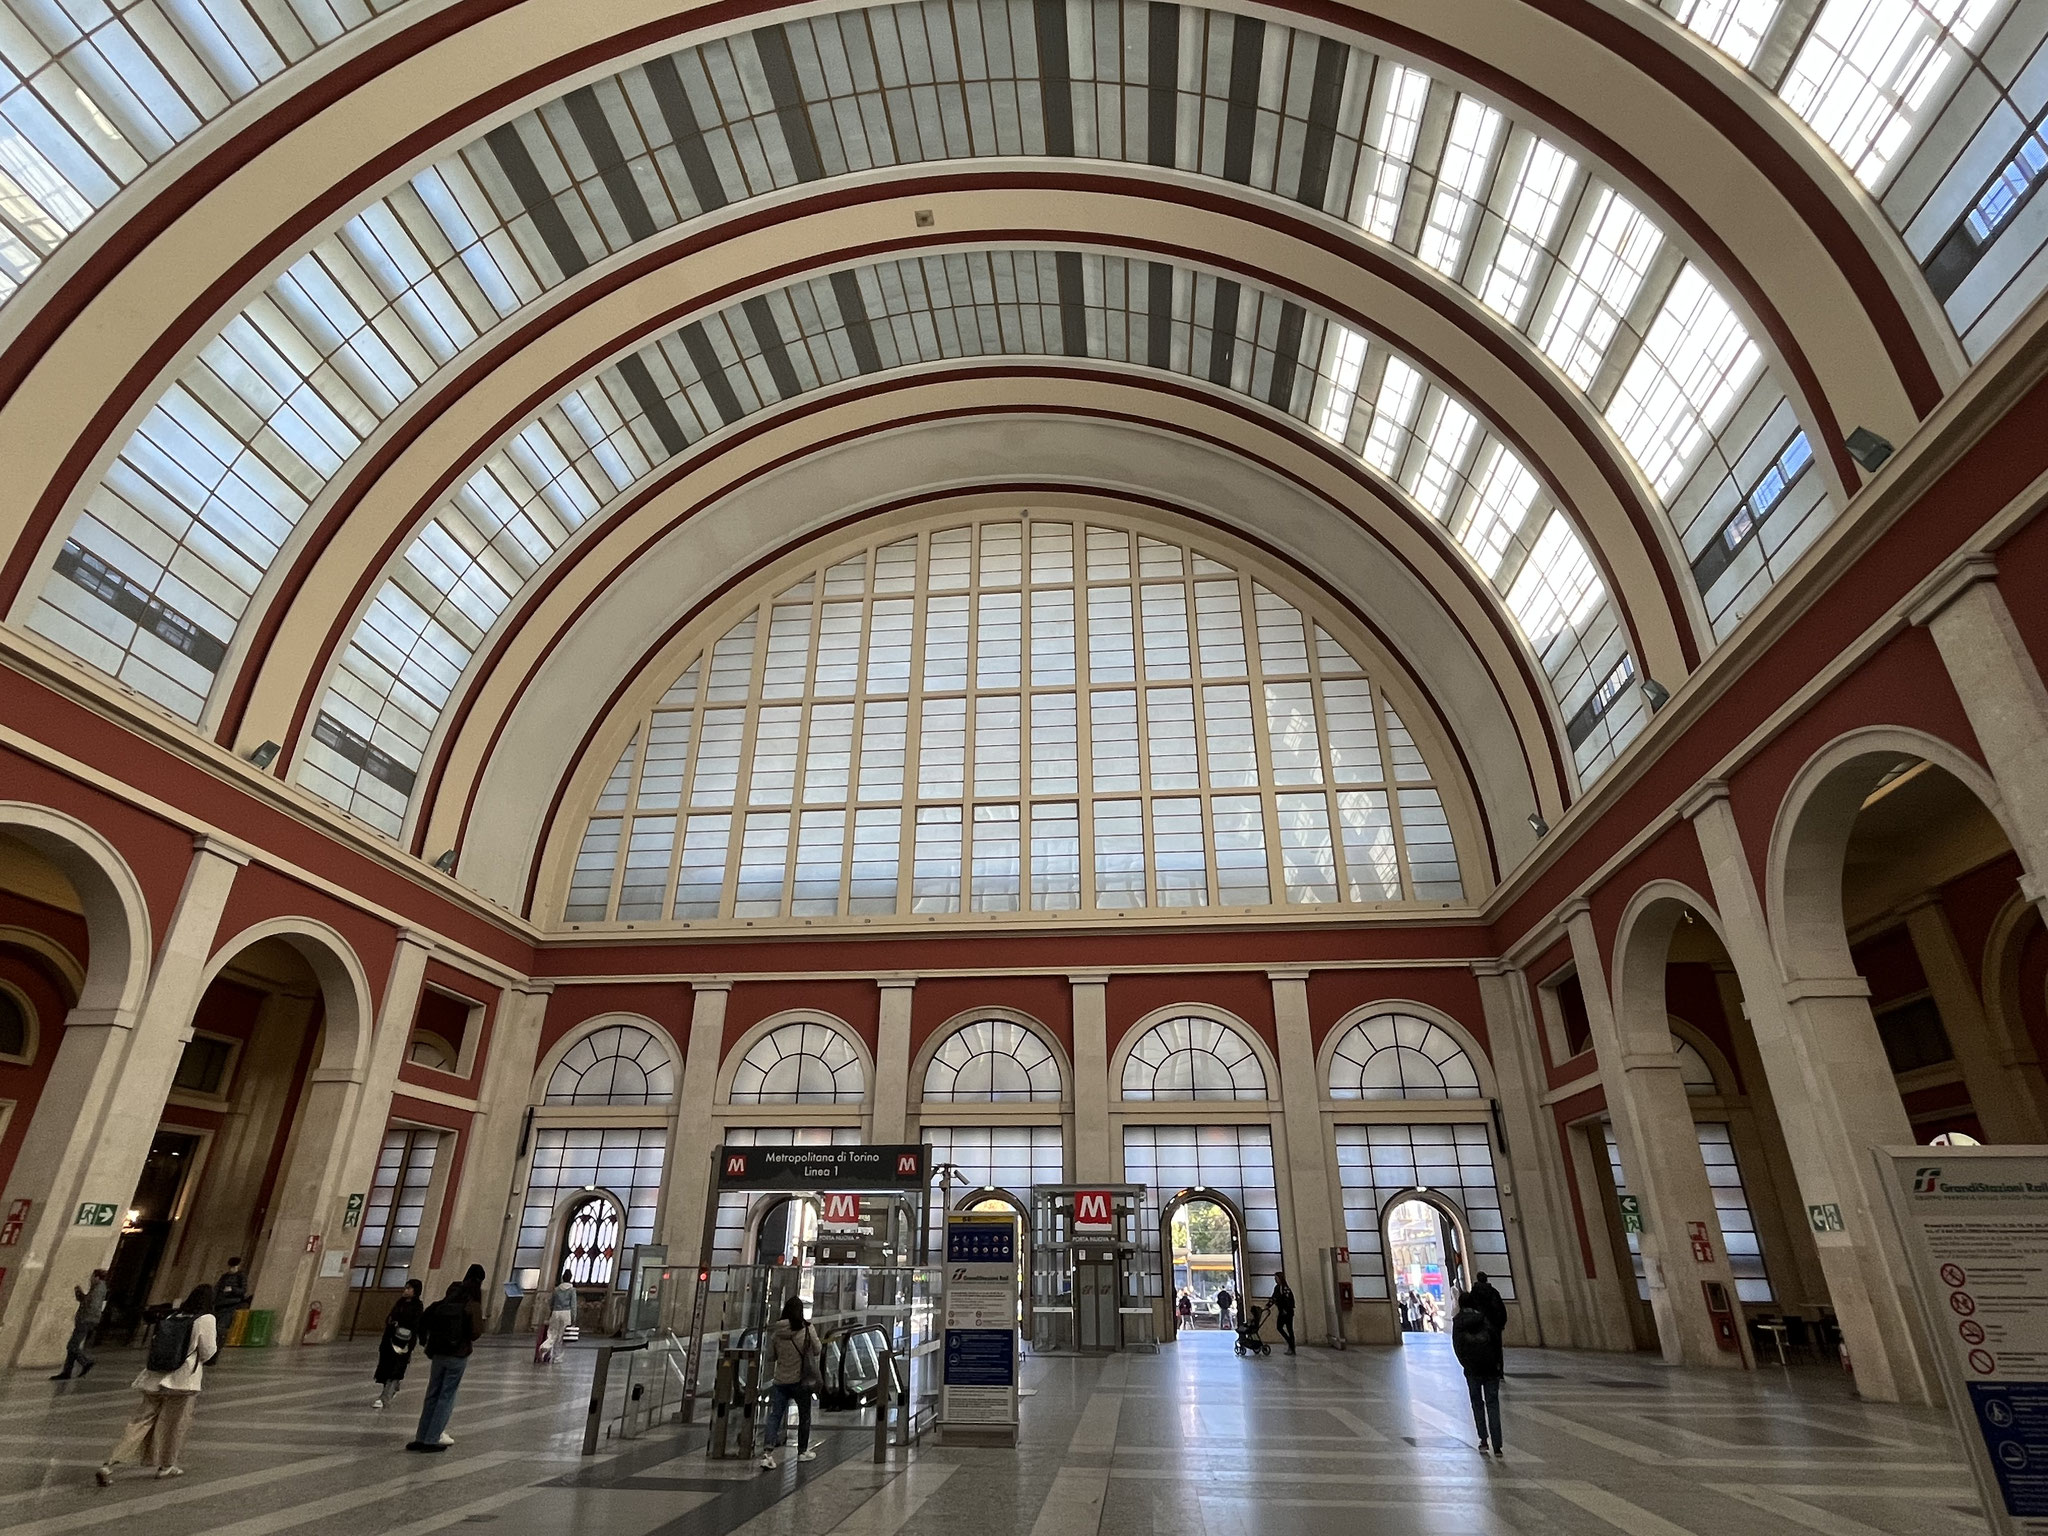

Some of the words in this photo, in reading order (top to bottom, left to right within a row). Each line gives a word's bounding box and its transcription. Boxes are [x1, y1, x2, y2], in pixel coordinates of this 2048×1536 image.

[765, 1152, 835, 1164] Metropolitana
[837, 1151, 847, 1162] di
[849, 1151, 880, 1162] Torino
[898, 1157, 916, 1171] M
[727, 1158, 744, 1172] M
[804, 1165, 830, 1177] Linea
[833, 1165, 839, 1177] 1
[1940, 1182, 2023, 1193] GrandiStazioni
[828, 1195, 855, 1218] M
[1079, 1195, 1107, 1218] M
